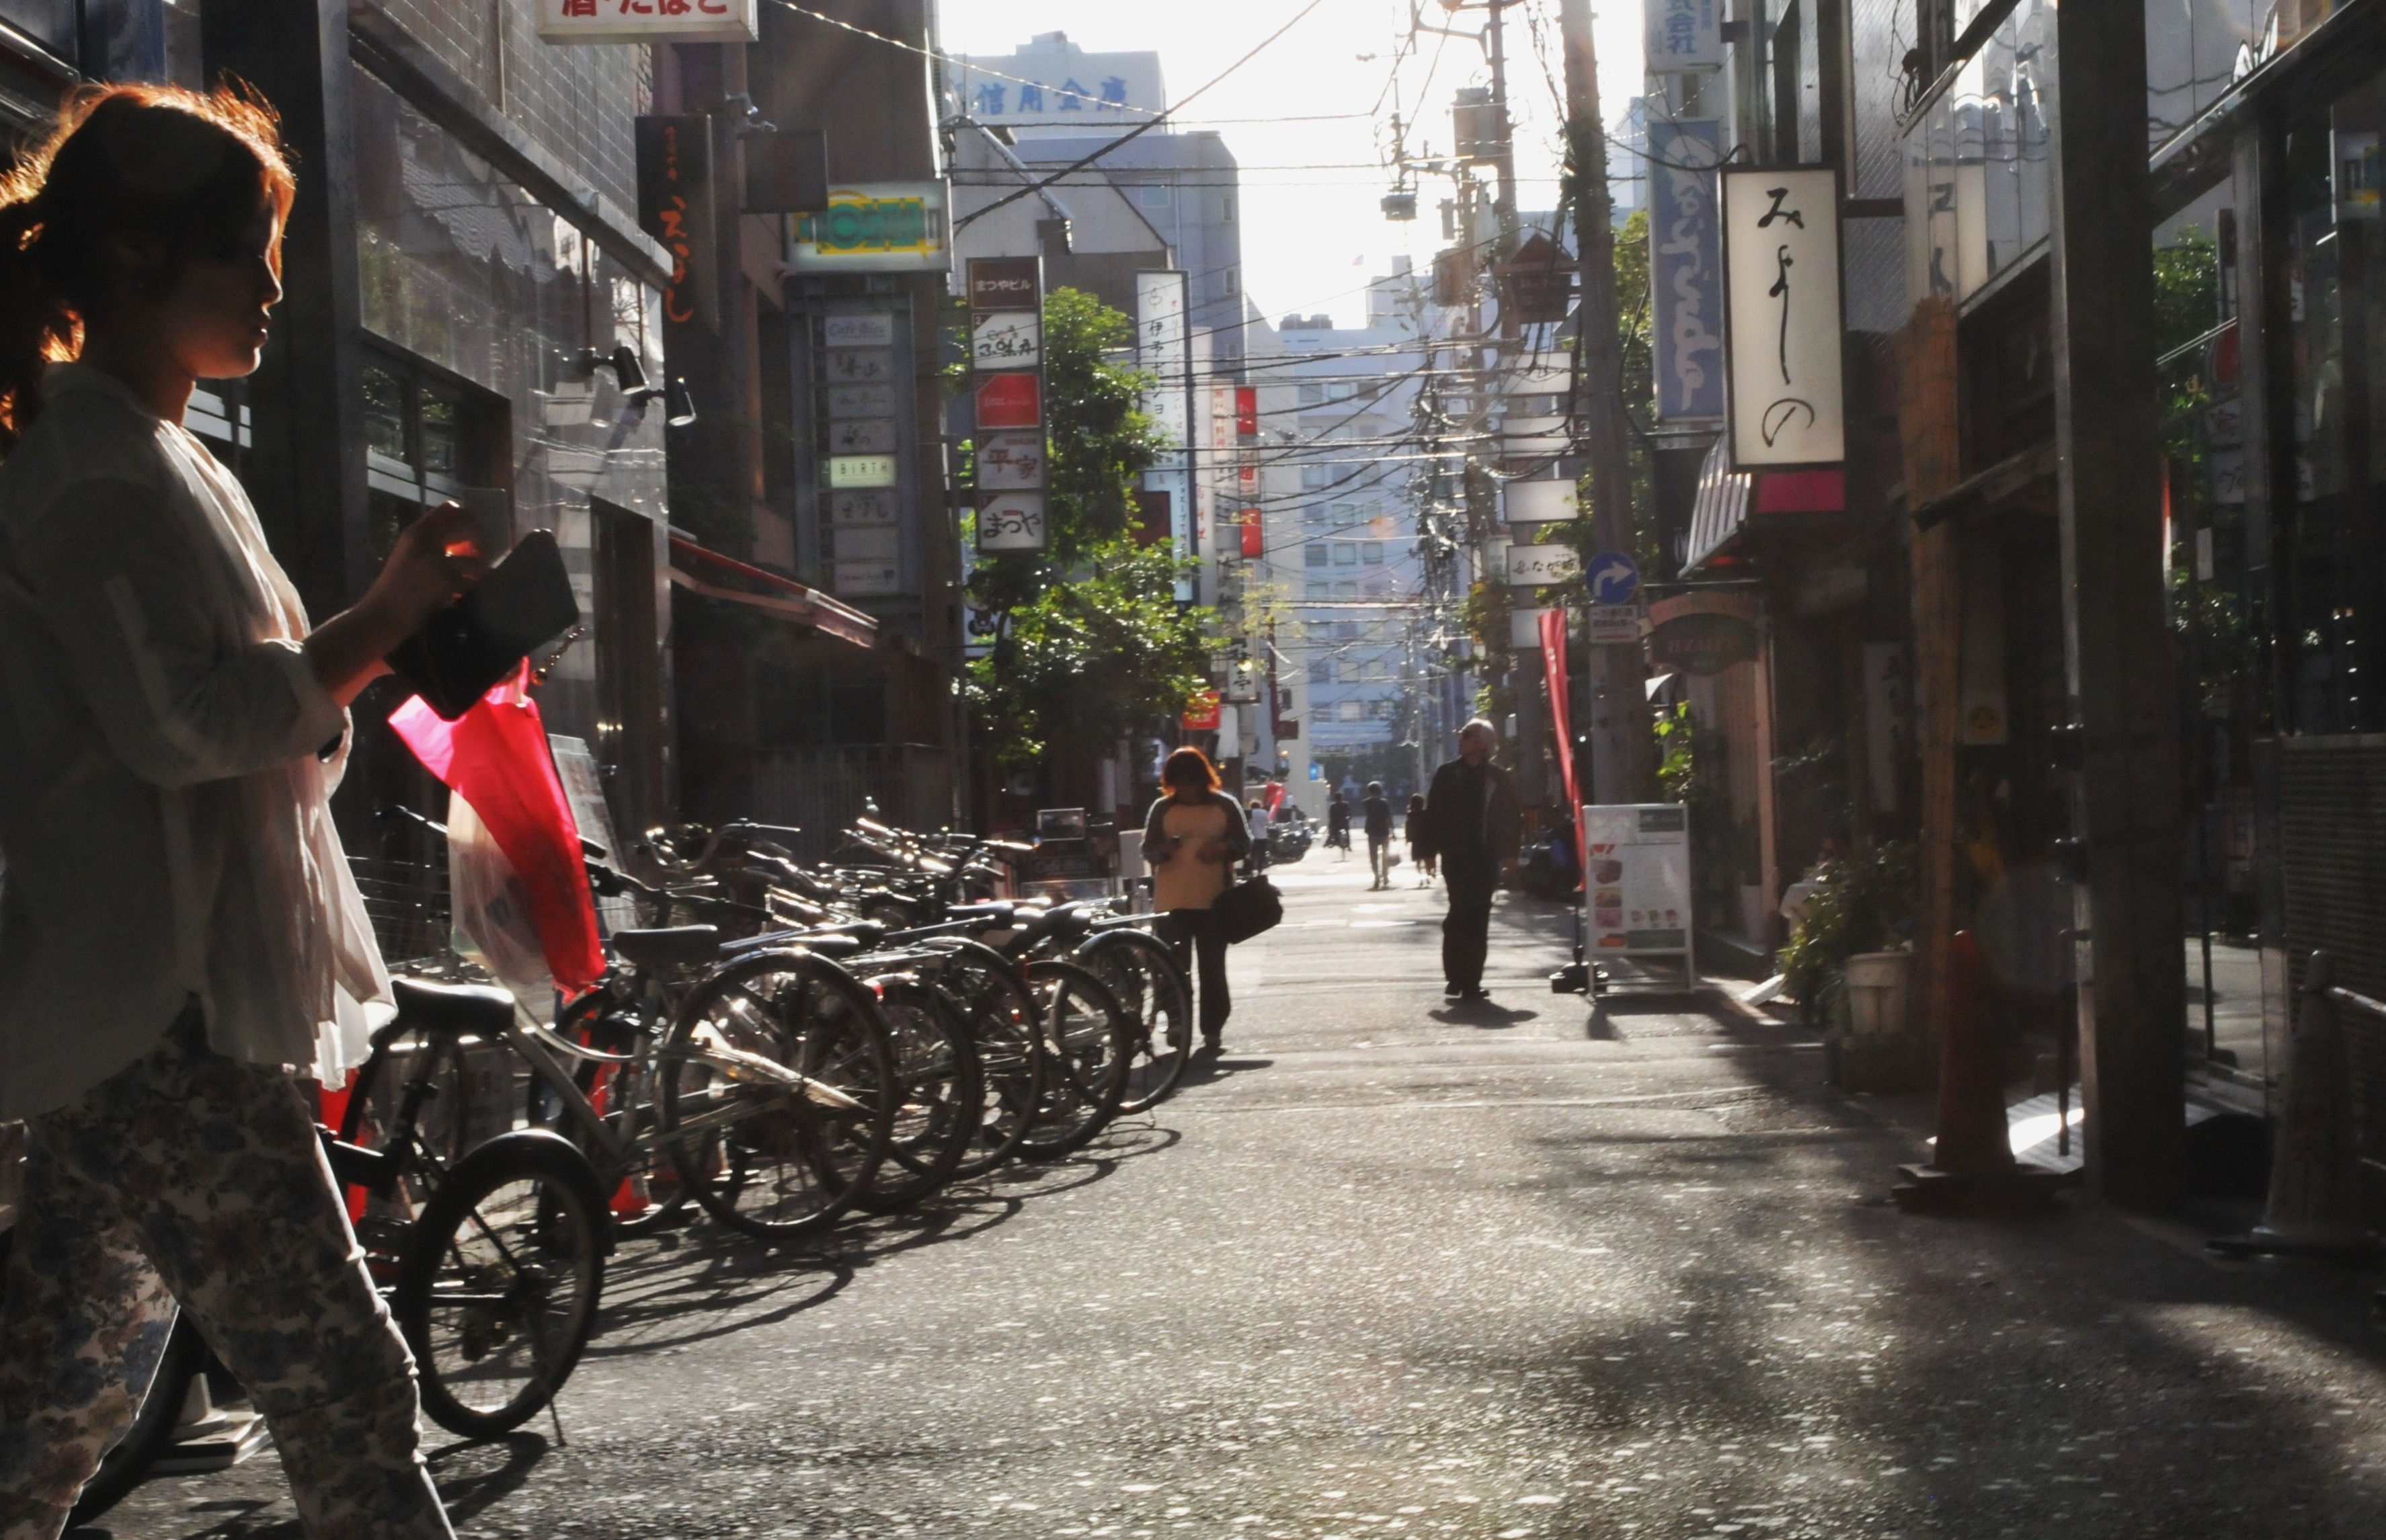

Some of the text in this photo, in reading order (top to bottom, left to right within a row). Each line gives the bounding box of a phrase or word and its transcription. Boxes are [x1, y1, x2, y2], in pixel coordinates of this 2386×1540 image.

[956, 76, 1128, 115] 信用金庫
[976, 279, 1031, 292] まつやビル
[983, 511, 1041, 538] まつや
